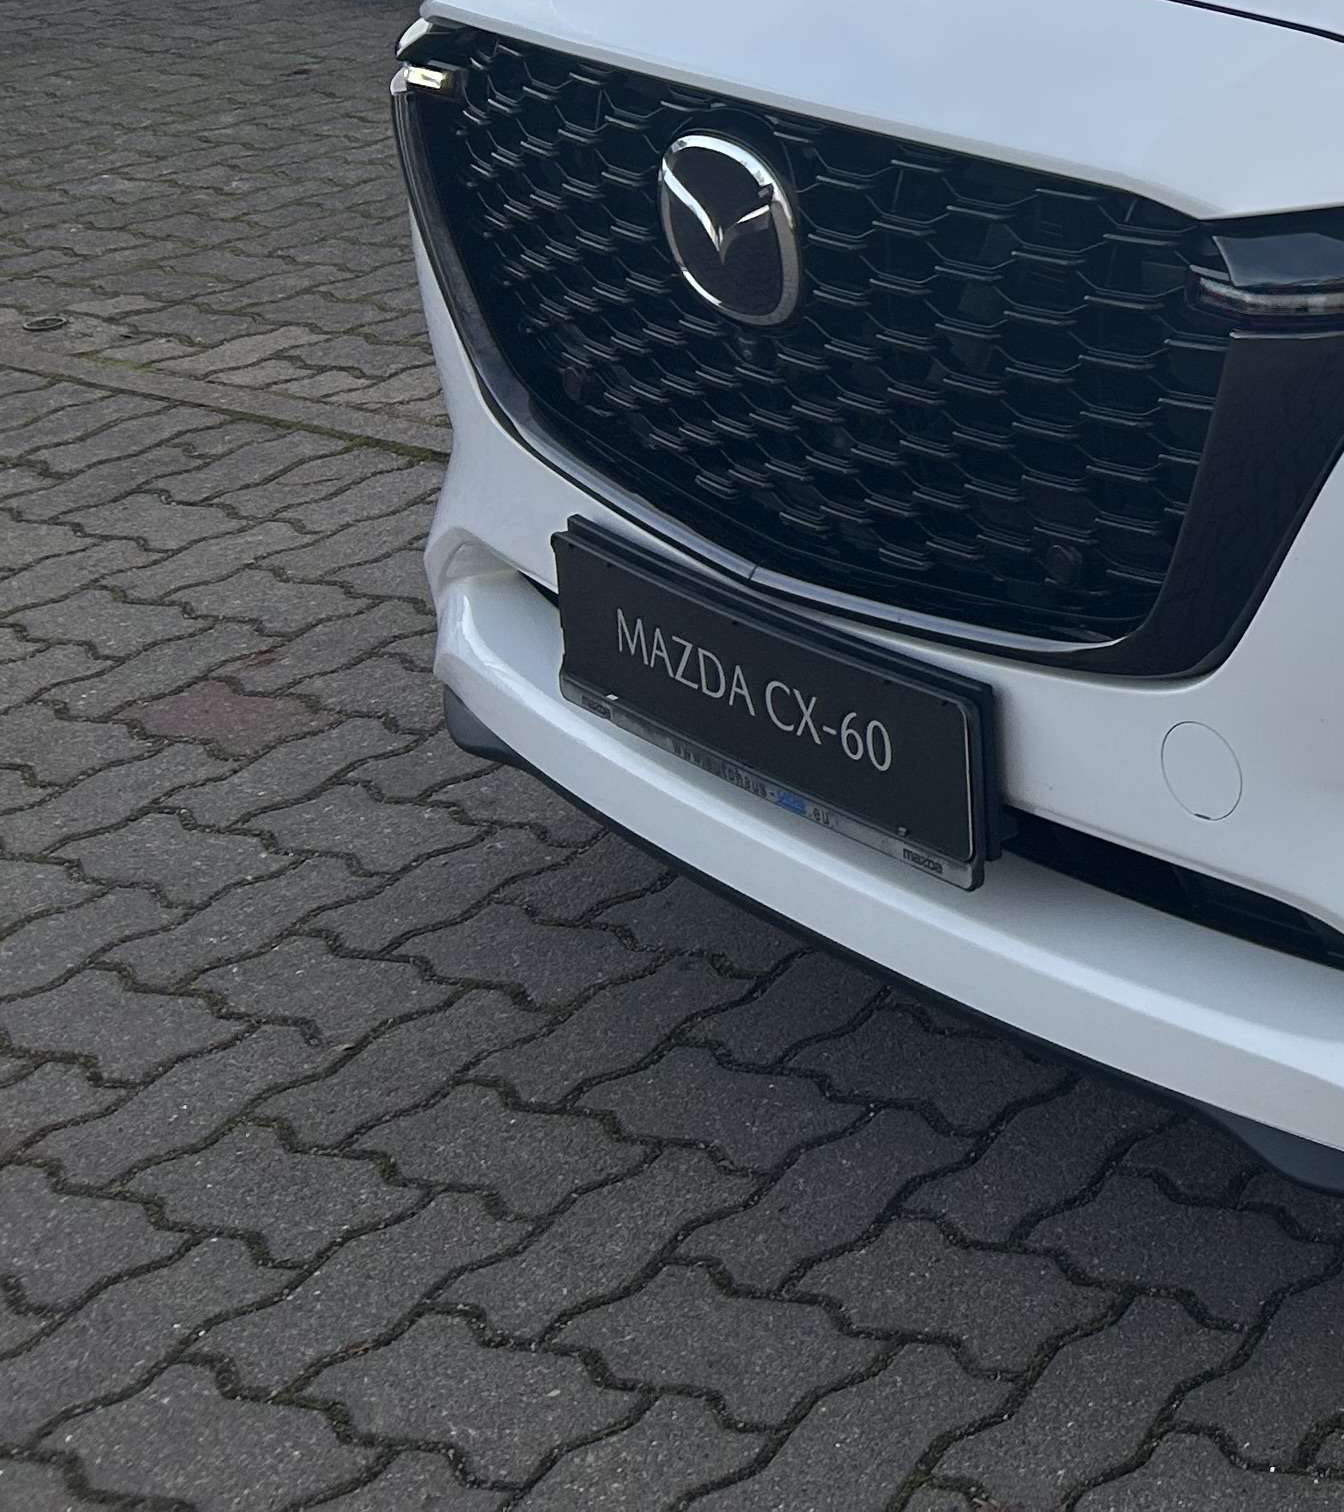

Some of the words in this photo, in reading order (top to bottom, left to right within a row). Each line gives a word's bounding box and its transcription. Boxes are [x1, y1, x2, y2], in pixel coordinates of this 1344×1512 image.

[616, 608, 756, 717] MAZDA
[765, 680, 893, 772] CX-60
[902, 847, 944, 875] mazda
